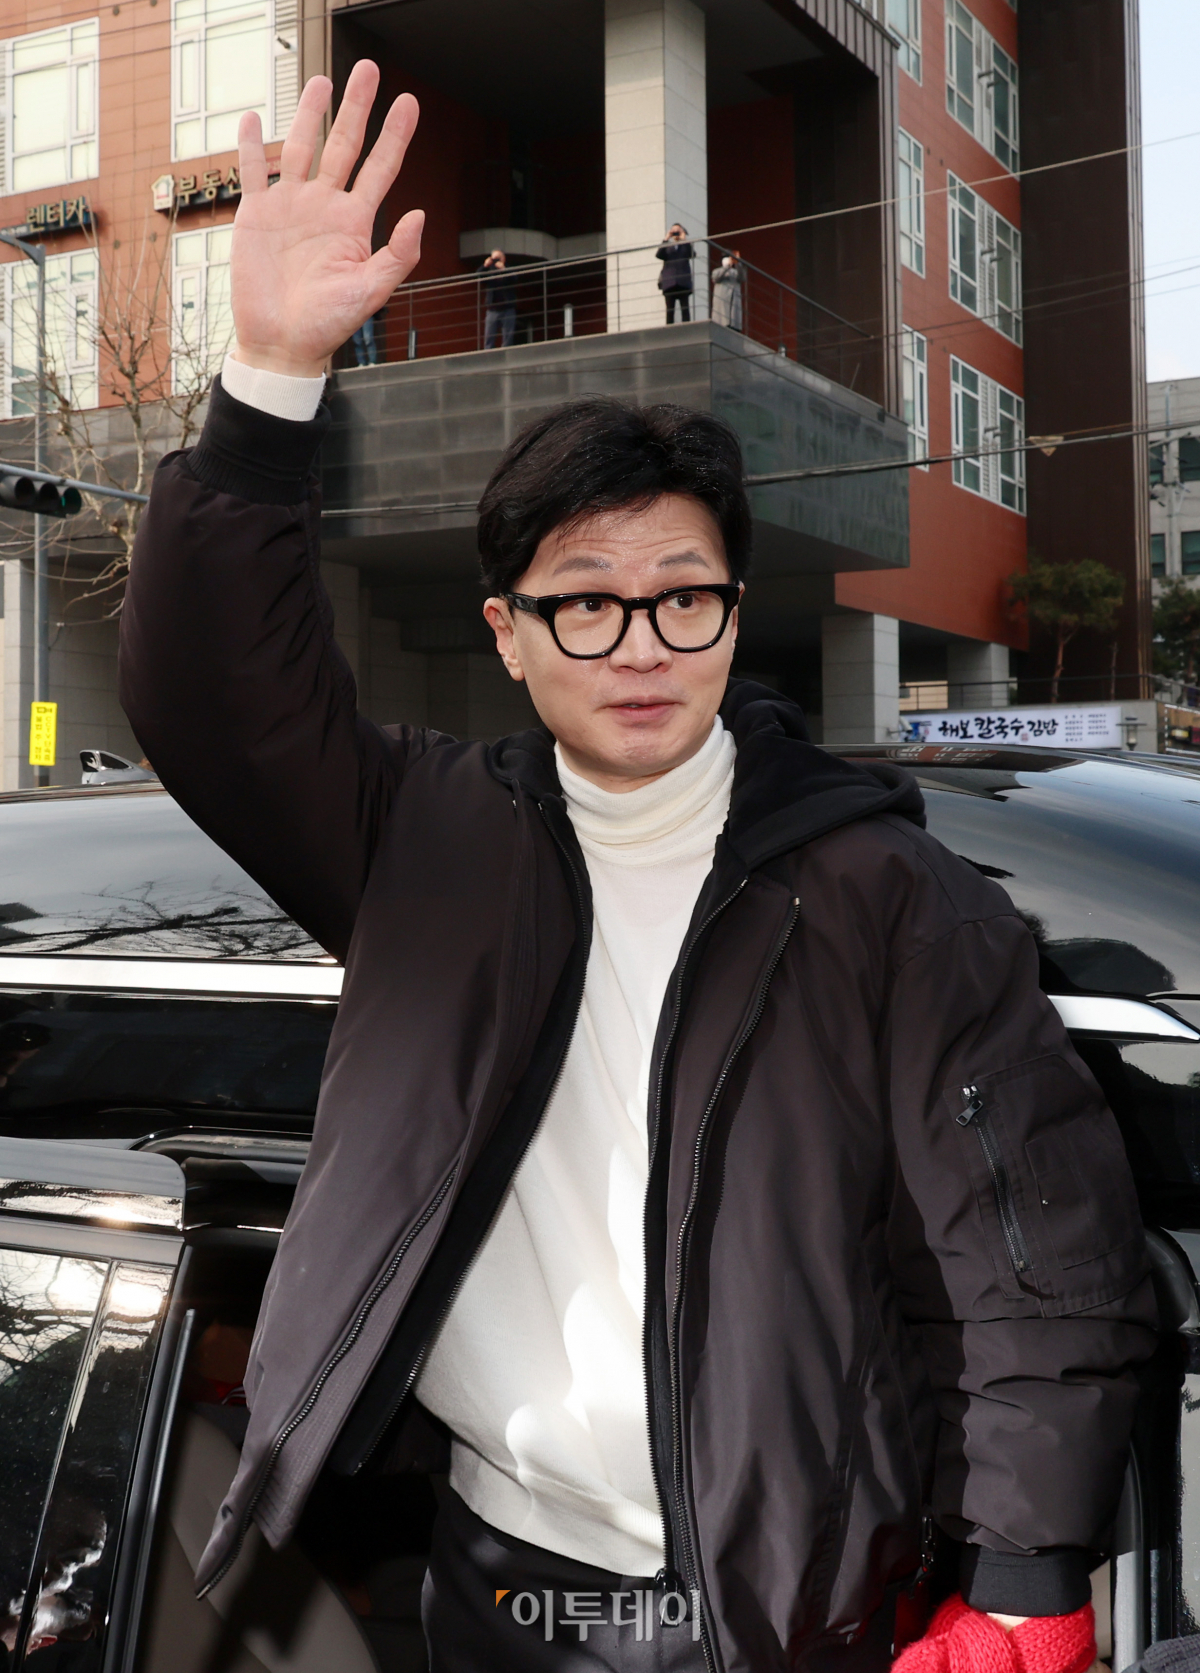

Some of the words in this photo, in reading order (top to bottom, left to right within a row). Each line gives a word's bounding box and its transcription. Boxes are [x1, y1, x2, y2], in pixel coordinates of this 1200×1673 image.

[26, 196, 88, 232] 렌터카
[974, 716, 1024, 740] 칼국수
[1027, 718, 1059, 737] 김밥
